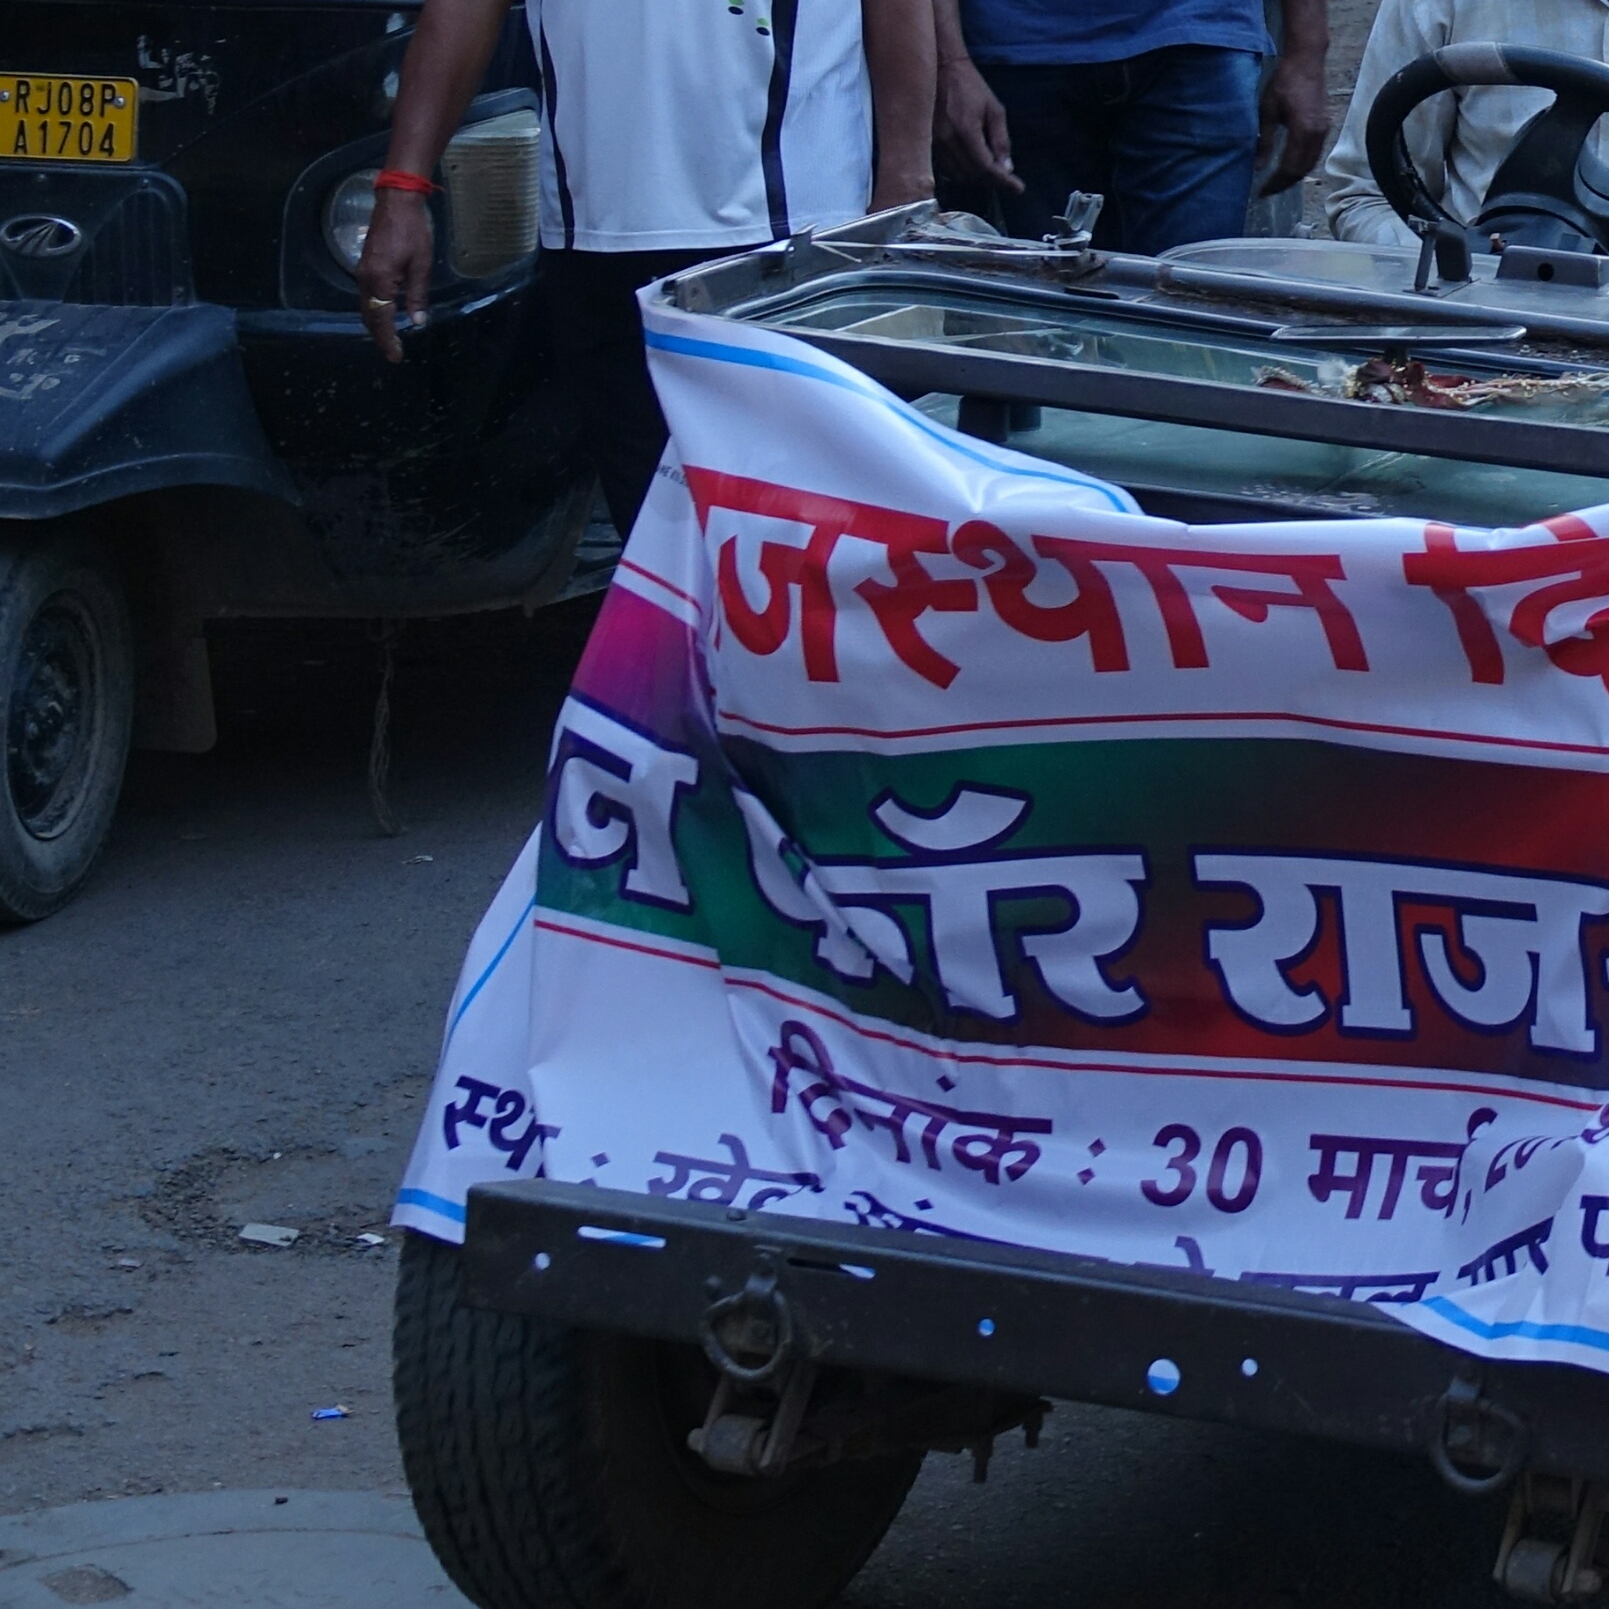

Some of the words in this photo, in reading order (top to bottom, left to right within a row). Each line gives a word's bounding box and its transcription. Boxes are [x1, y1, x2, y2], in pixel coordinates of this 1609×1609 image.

[13, 120, 116, 157] A1704
[15, 79, 117, 119] RJ08P
[684, 465, 1368, 691] जस्थान
[769, 1019, 1052, 1184] दिनांक
[1140, 1123, 1264, 1215] 30
